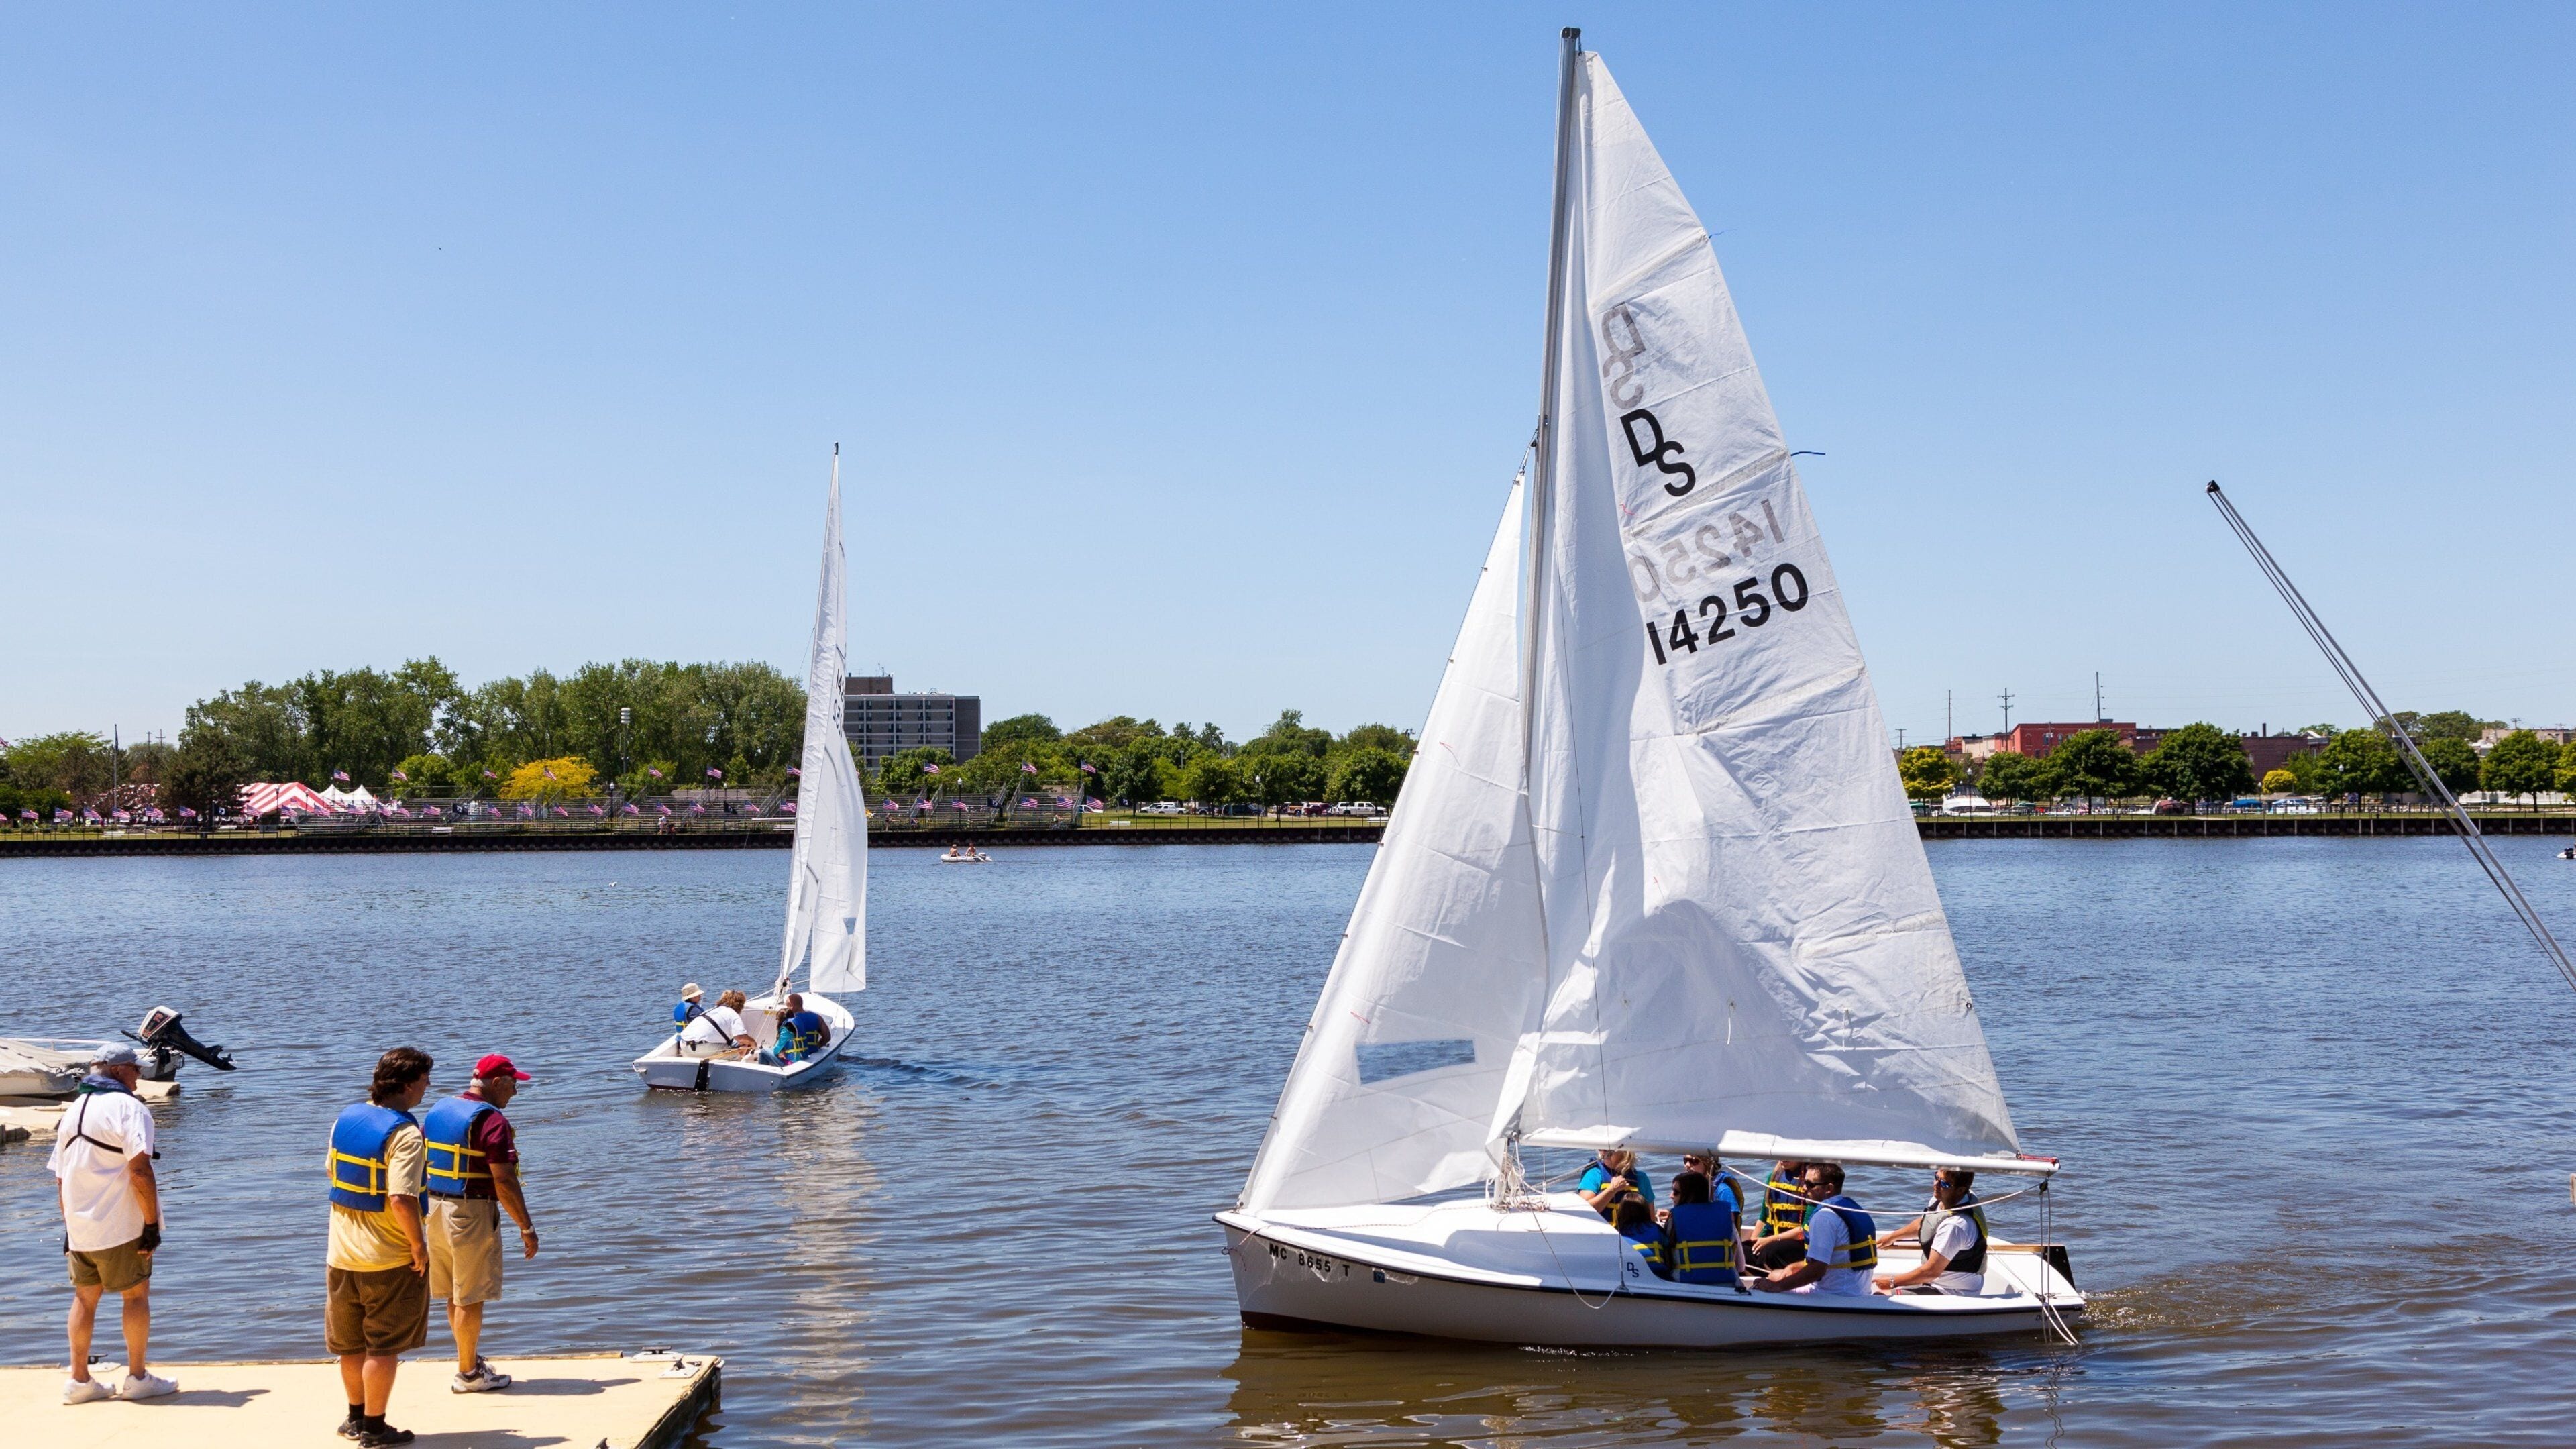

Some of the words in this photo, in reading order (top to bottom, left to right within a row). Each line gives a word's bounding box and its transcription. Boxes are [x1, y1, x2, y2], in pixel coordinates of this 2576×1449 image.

[1619, 408, 1696, 497] DS
[1646, 563, 1808, 665] 14250
[1269, 1243, 1287, 1260] MC
[1299, 1253, 1330, 1272] 8655
[1342, 1264, 1350, 1277] T
[1627, 1262, 1639, 1277] DS
